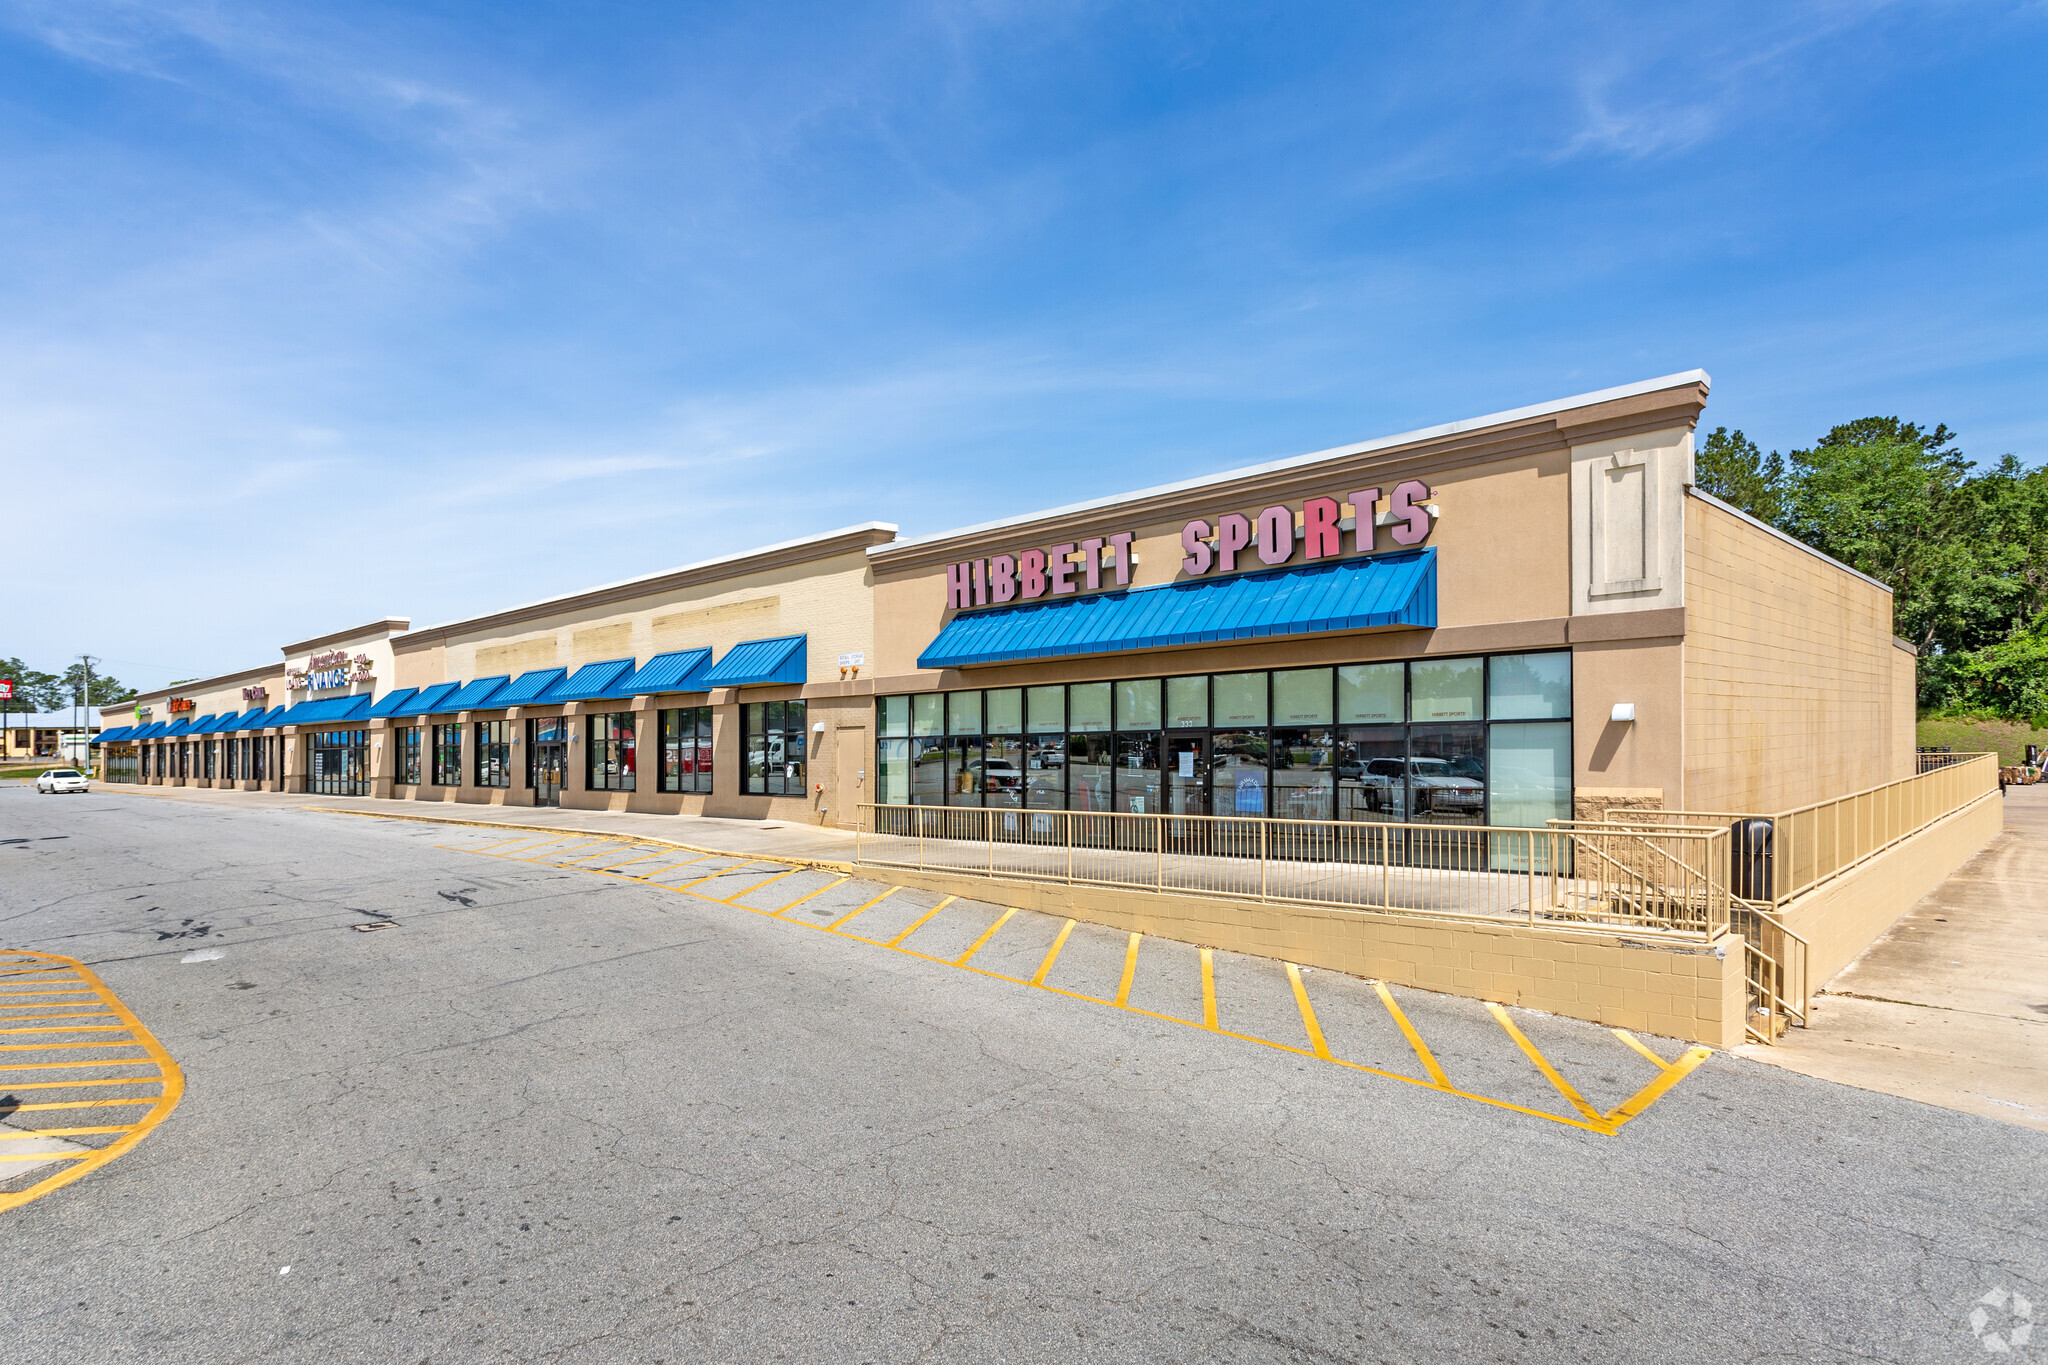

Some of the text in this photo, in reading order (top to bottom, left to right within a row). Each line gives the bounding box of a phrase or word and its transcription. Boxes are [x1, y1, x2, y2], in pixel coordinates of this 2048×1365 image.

[946, 480, 1432, 609] HIBBETT SPORTS
[308, 668, 345, 691] FINANCE
